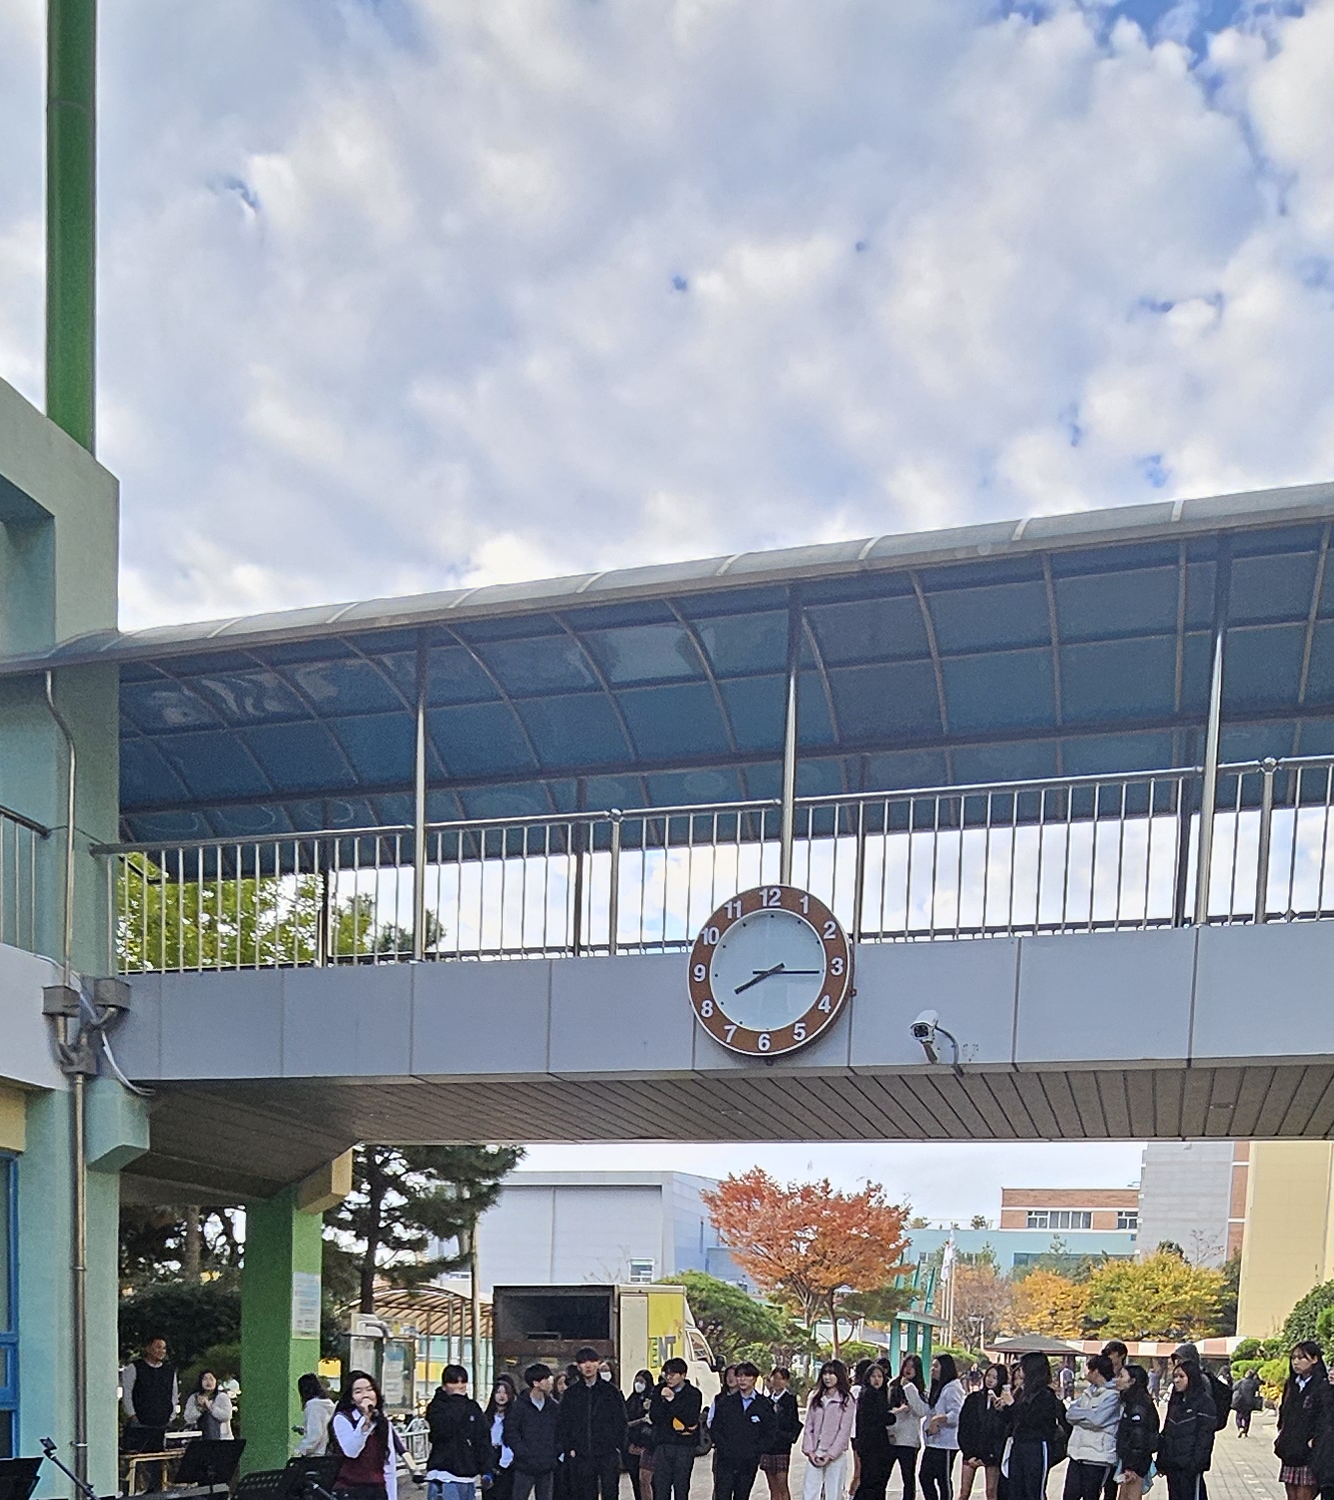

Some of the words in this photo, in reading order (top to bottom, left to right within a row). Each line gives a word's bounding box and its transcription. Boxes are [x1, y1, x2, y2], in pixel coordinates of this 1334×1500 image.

[759, 888, 782, 907] 12
[799, 895, 809, 914] 1
[724, 900, 742, 919] 11
[701, 927, 720, 945] 10
[823, 921, 837, 940] 2
[693, 964, 706, 982] 9
[831, 957, 844, 976] 3
[701, 1000, 714, 1018] 8
[818, 995, 832, 1013] 4
[724, 1025, 737, 1043] 7
[793, 1023, 807, 1041] 5
[758, 1033, 771, 1051] 6
